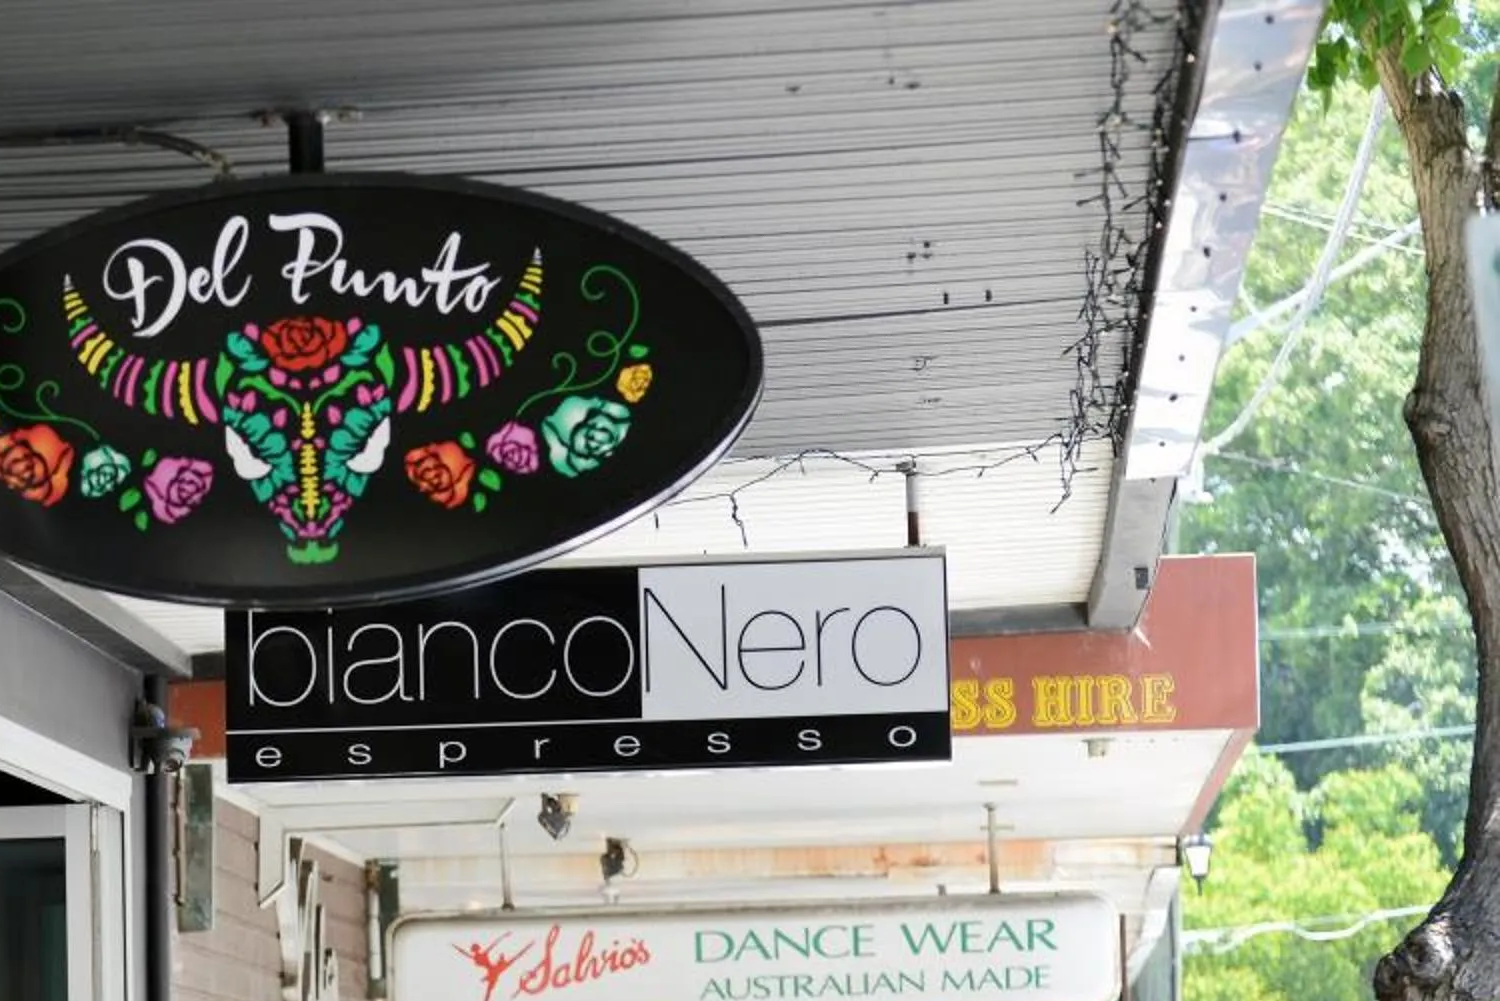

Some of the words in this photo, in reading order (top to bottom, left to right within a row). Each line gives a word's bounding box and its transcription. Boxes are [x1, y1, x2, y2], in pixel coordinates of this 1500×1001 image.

[102, 215, 254, 338] Del
[268, 211, 502, 318] Punto
[952, 678, 1017, 729] SS
[1031, 673, 1177, 727] HIRE
[254, 723, 918, 769] espresso
[510, 922, 652, 1000] Salvio's
[694, 924, 876, 964] DANCE
[900, 918, 1058, 954] WEAR
[699, 970, 925, 1001] AUSTRALIAN
[941, 965, 1051, 992] MADE
